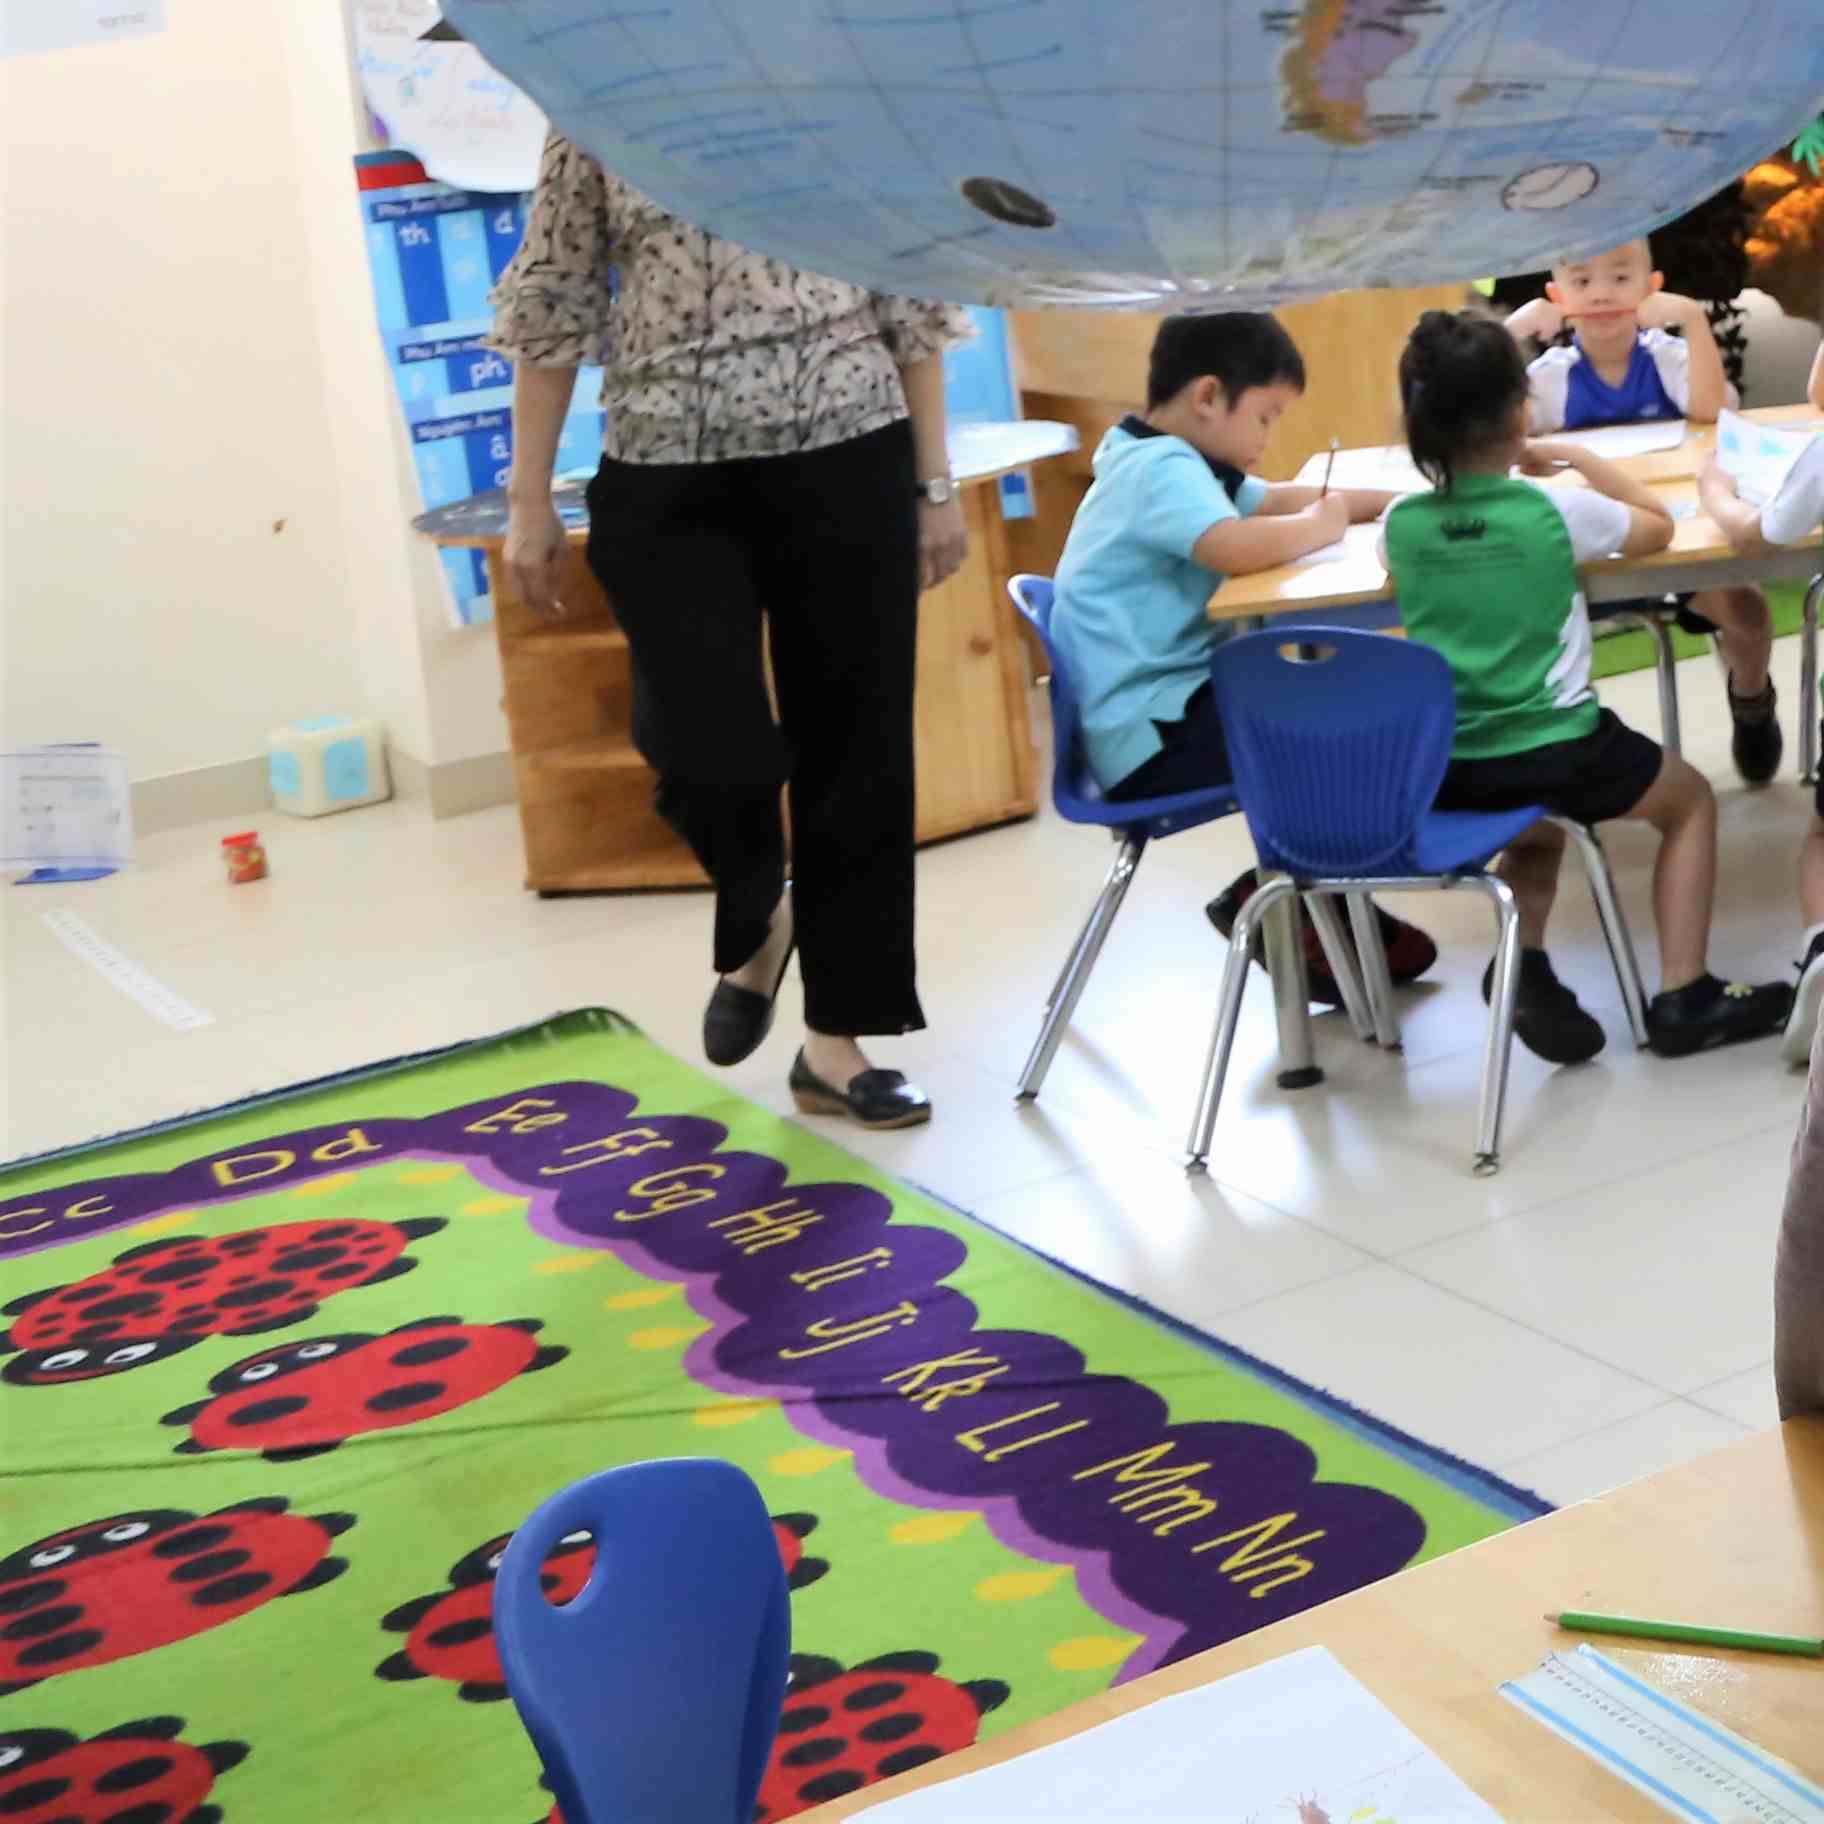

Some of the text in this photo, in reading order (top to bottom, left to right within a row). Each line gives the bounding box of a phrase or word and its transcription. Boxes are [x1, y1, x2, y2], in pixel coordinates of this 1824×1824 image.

[470, 354, 508, 388] ph
[464, 1097, 569, 1135] Ee
[211, 1127, 384, 1187] Dd
[539, 1127, 674, 1176] Ff
[614, 1162, 727, 1223] Gg
[709, 1198, 823, 1256] Hh
[789, 1247, 891, 1292] Ii
[779, 1301, 918, 1360] Jj
[881, 1348, 1010, 1413] Kk
[955, 1402, 1088, 1463] Ll
[1073, 1440, 1217, 1536] Mm
[1192, 1512, 1326, 1599] Nn
